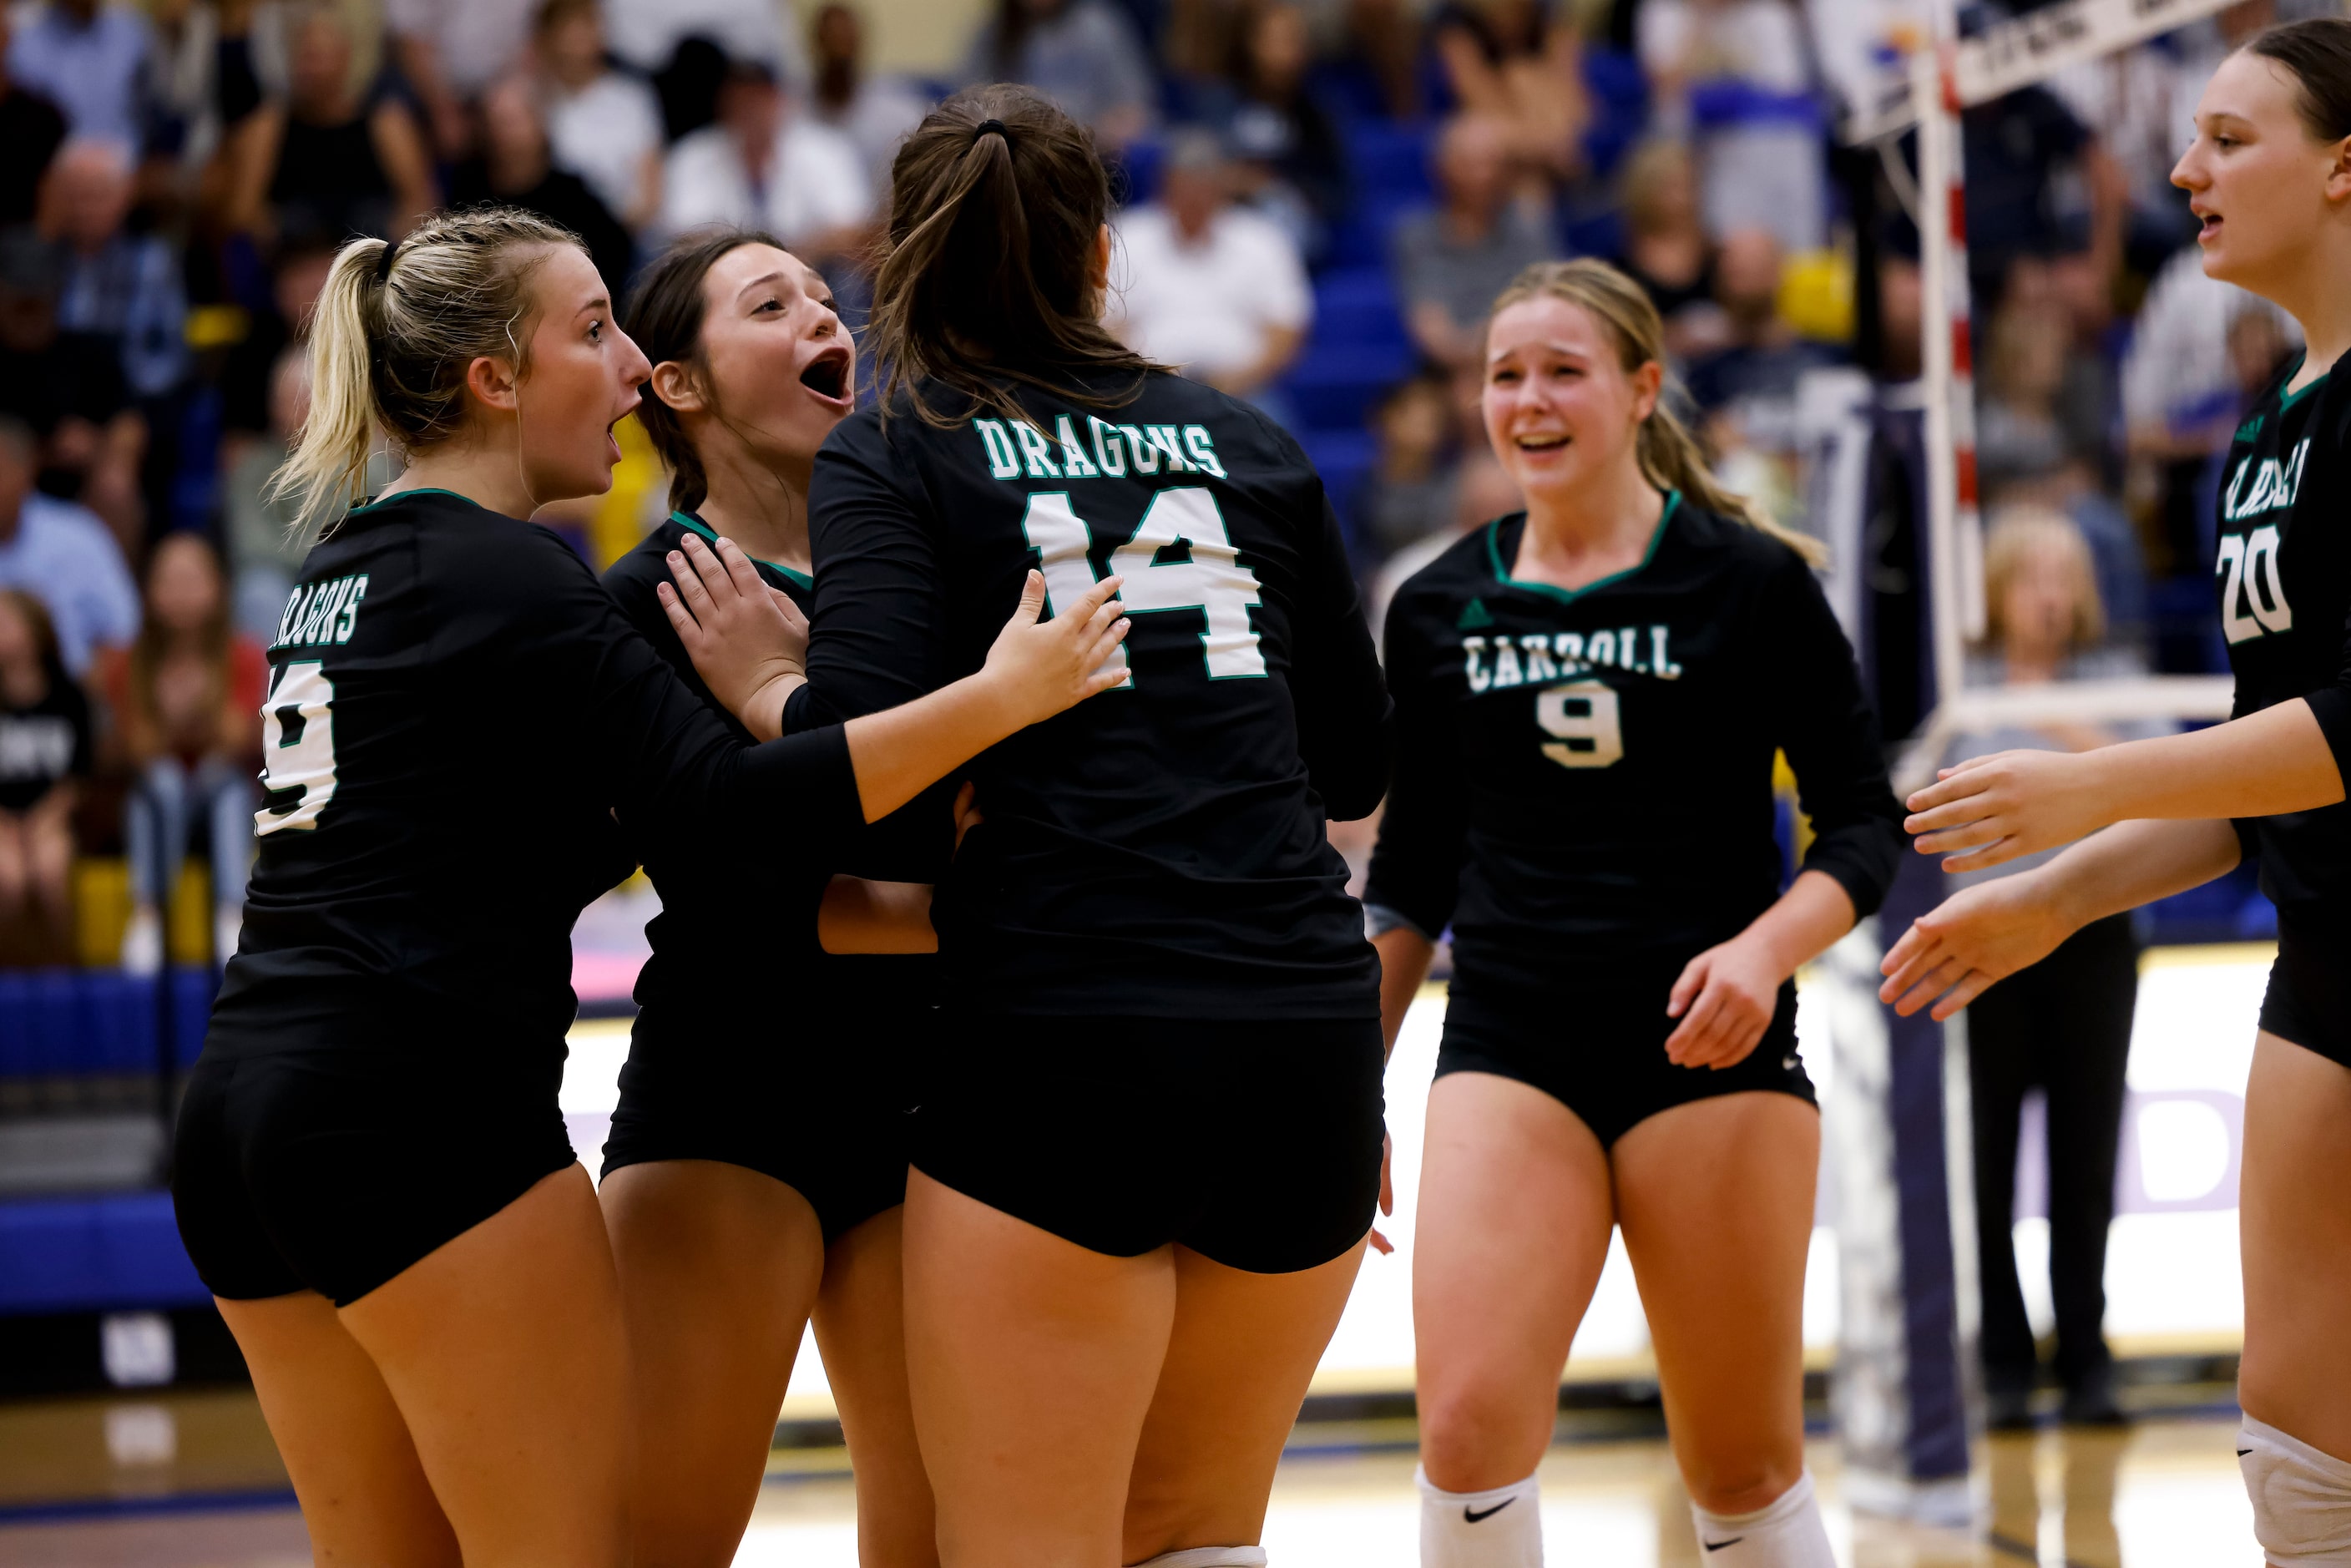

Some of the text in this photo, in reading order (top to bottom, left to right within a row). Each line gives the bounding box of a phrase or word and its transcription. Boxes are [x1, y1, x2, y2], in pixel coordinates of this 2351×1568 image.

[973, 413, 1227, 480] DRAGONS
[267, 573, 369, 652] RAGONS
[1021, 485, 1269, 691] 14
[2215, 524, 2293, 646] 20
[1536, 679, 1625, 768] 9
